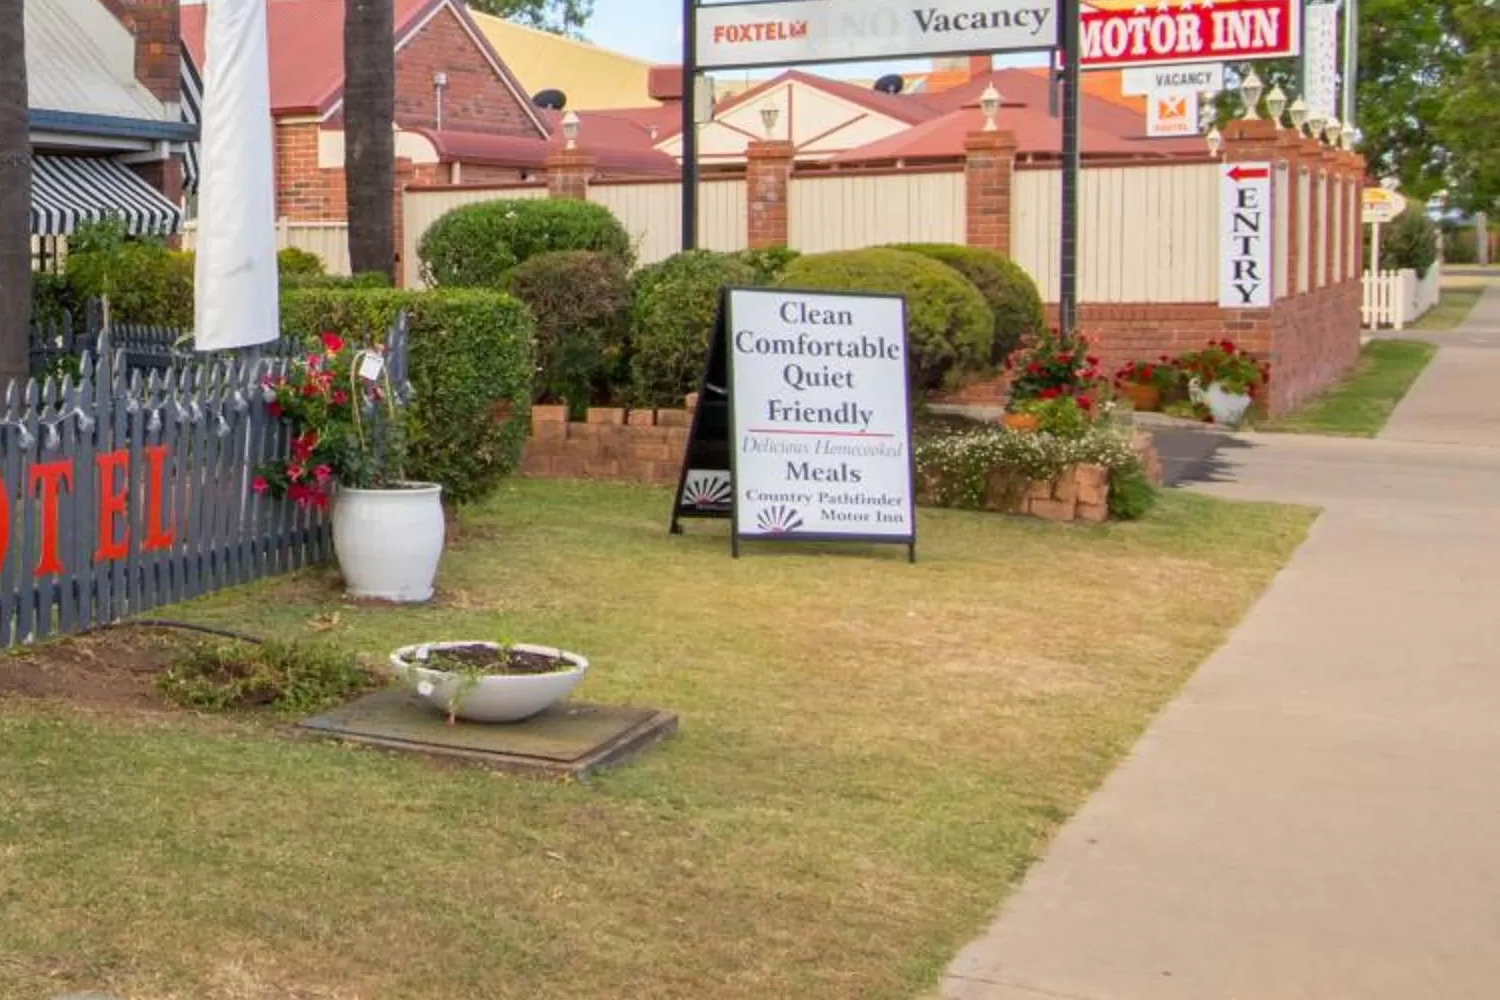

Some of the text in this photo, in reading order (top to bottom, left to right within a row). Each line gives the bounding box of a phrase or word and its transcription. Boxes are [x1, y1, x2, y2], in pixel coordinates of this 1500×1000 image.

[713, 21, 789, 45] FOXTEL
[913, 6, 1052, 34] Vacancy
[1080, 7, 1281, 59] MOTOR INN
[1155, 71, 1213, 86] VACANCY
[1232, 187, 1262, 305] ENTRY
[779, 300, 853, 326] Clean
[735, 329, 901, 361] Comfortable
[782, 362, 856, 392] Quiet
[767, 399, 875, 432] Friendly
[742, 435, 810, 455] Delicious
[785, 460, 862, 484] Meals
[745, 488, 904, 507] Country Pathfinder
[820, 508, 905, 524] Motor Inn
